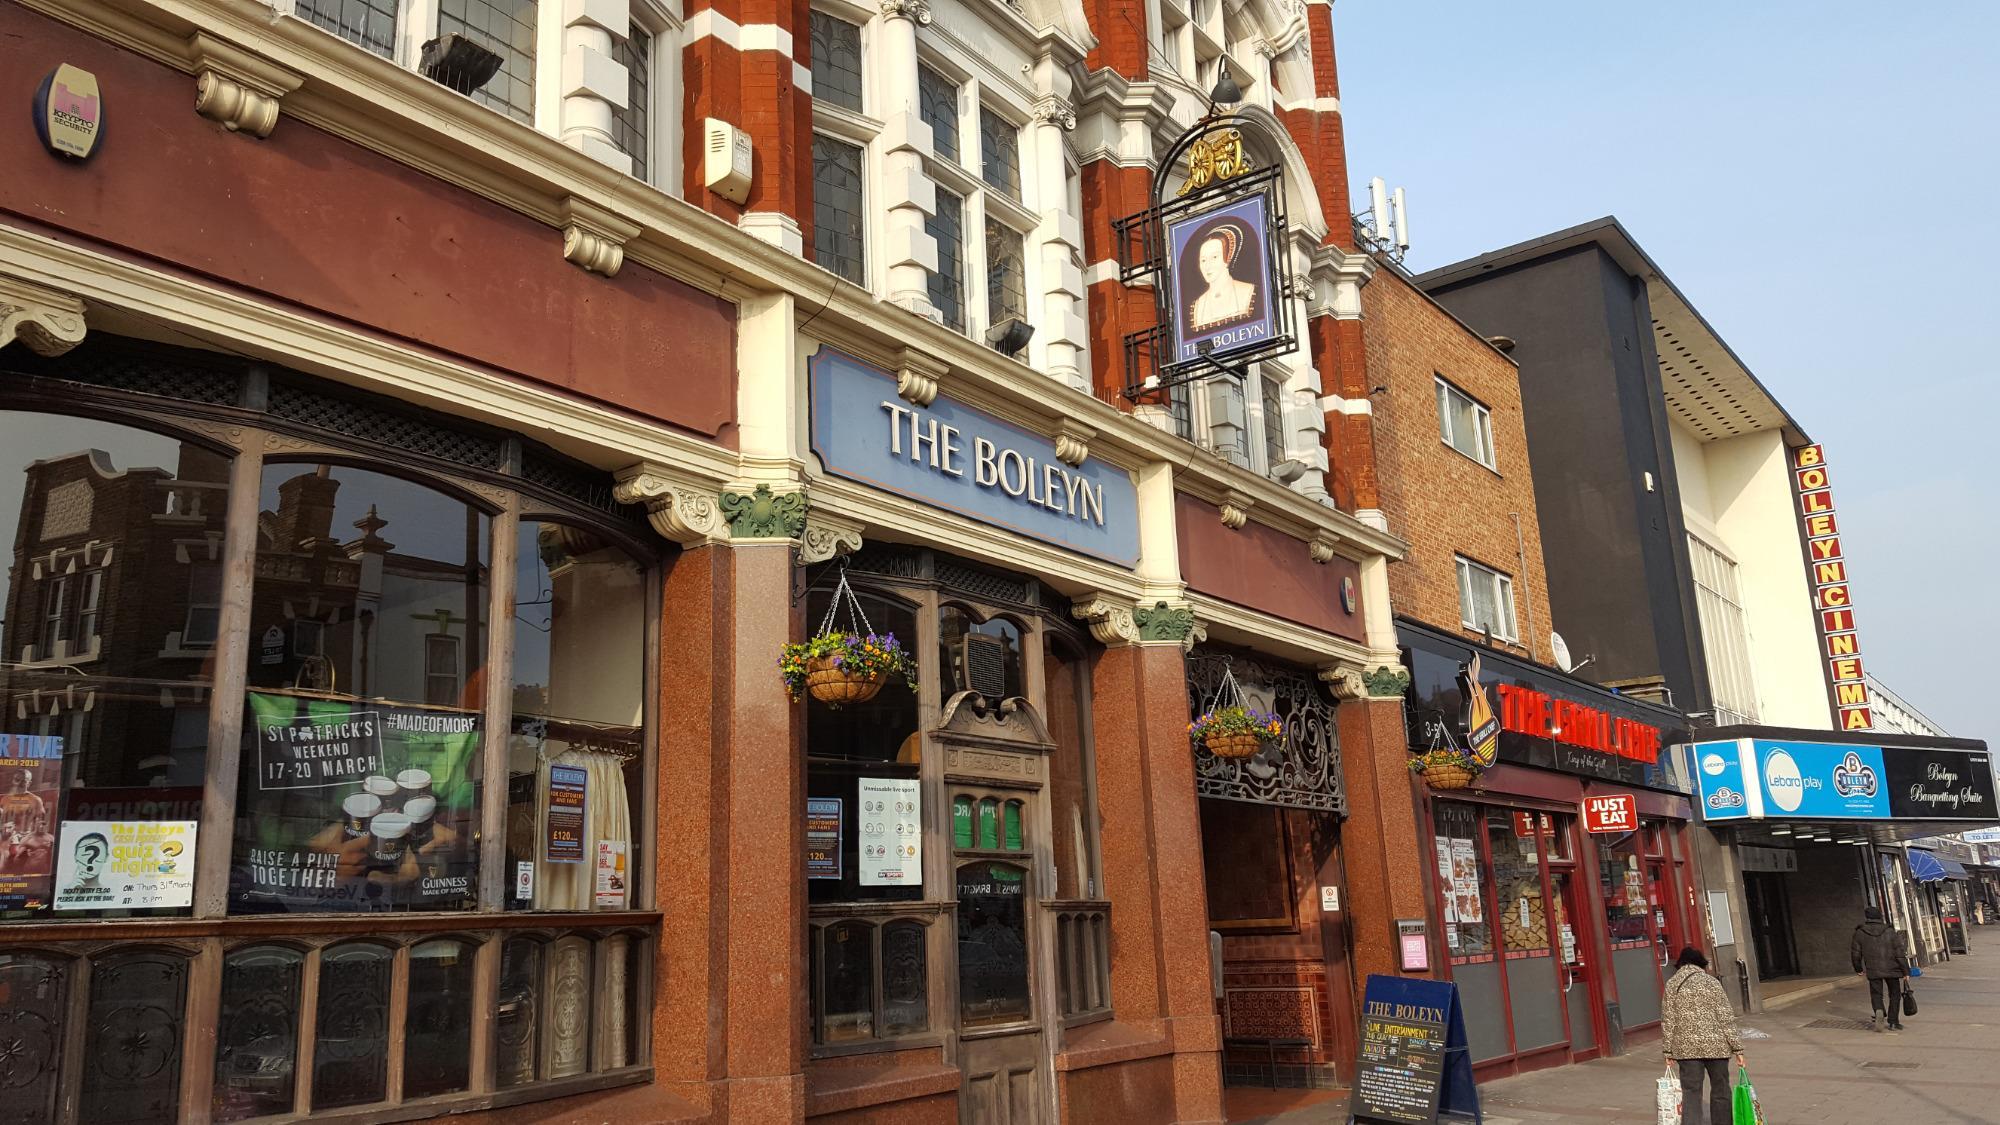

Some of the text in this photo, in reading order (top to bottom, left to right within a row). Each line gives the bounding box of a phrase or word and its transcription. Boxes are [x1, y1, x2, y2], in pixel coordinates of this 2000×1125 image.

[53, 109, 94, 129] KRYPTO
[54, 117, 92, 135] SECURITY
[1213, 323, 1265, 349] BOLEYN
[881, 400, 1104, 526] THE BOLEYN
[1799, 447, 1840, 582] BOLEYN
[1824, 587, 1870, 730] CINEMA
[1496, 683, 1552, 739] THE
[268, 721, 374, 743] ST PTRICK'S
[16, 735, 63, 759] TIME
[293, 743, 349, 759] WEEKEND
[19, 759, 39, 767] 2016
[268, 755, 377, 779] 17-20 MARCH
[1850, 757, 1858, 772] B
[1803, 776, 1823, 790] play
[1928, 763, 1958, 788] Boleyn
[1591, 797, 1626, 813] JUST
[1961, 785, 1983, 806] Suite
[1600, 810, 1628, 825] EAT
[553, 831, 571, 841] £120
[111, 843, 154, 862] quiz
[250, 849, 341, 869] RAISE A PINT
[111, 859, 160, 878] night
[252, 864, 337, 888] TOGETHER
[136, 883, 158, 891] Thurs
[422, 877, 468, 889] GUINNESS
[1369, 1000, 1444, 1022] THE BOLEYN
[1369, 1022, 1429, 1039] LIVE ENTERTAINMENT
